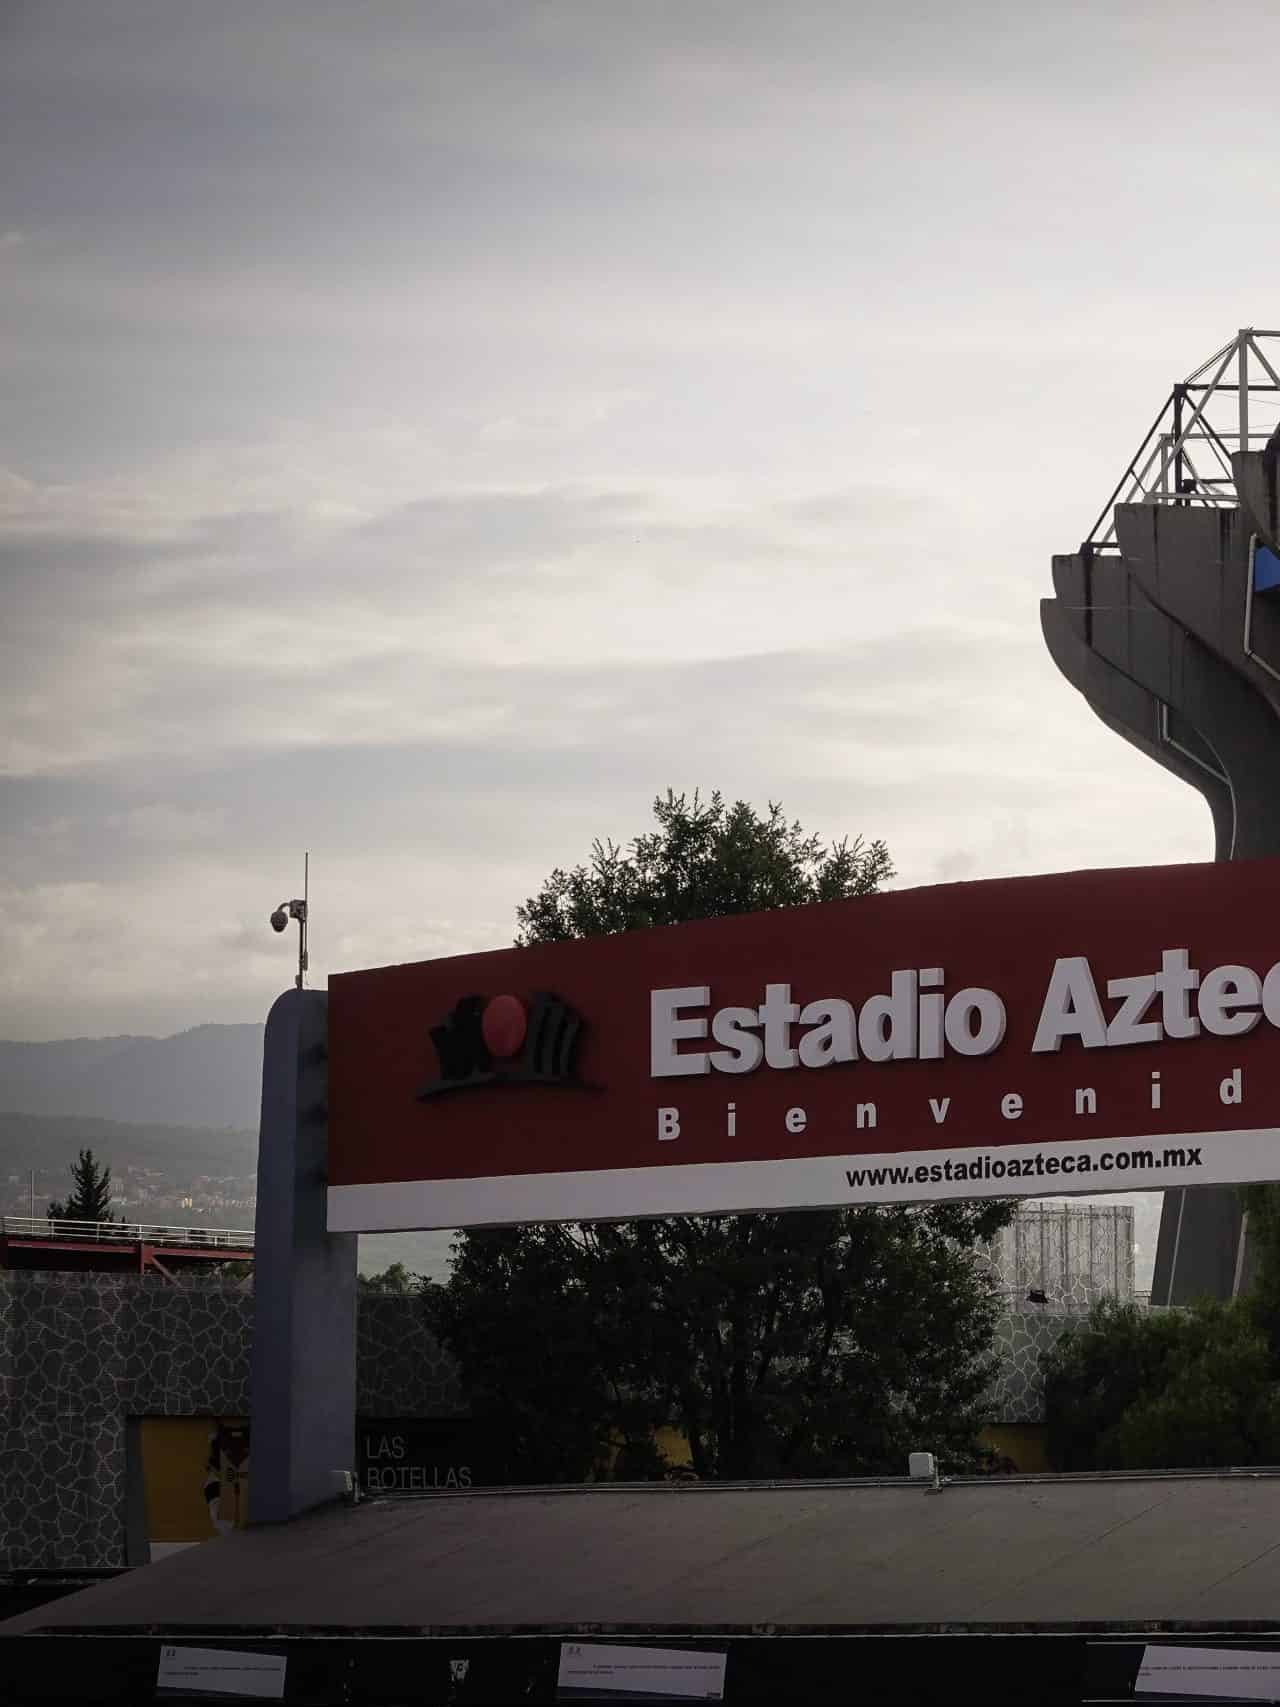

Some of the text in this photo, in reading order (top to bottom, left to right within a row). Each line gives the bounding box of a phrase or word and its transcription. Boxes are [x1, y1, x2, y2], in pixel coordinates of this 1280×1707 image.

[649, 967, 1007, 1078] Estadio
[846, 1146, 1202, 1187] www.estadioazteca.com.mx
[368, 1435, 405, 1459] LAS
[367, 1466, 472, 1488] BOTELLAS
